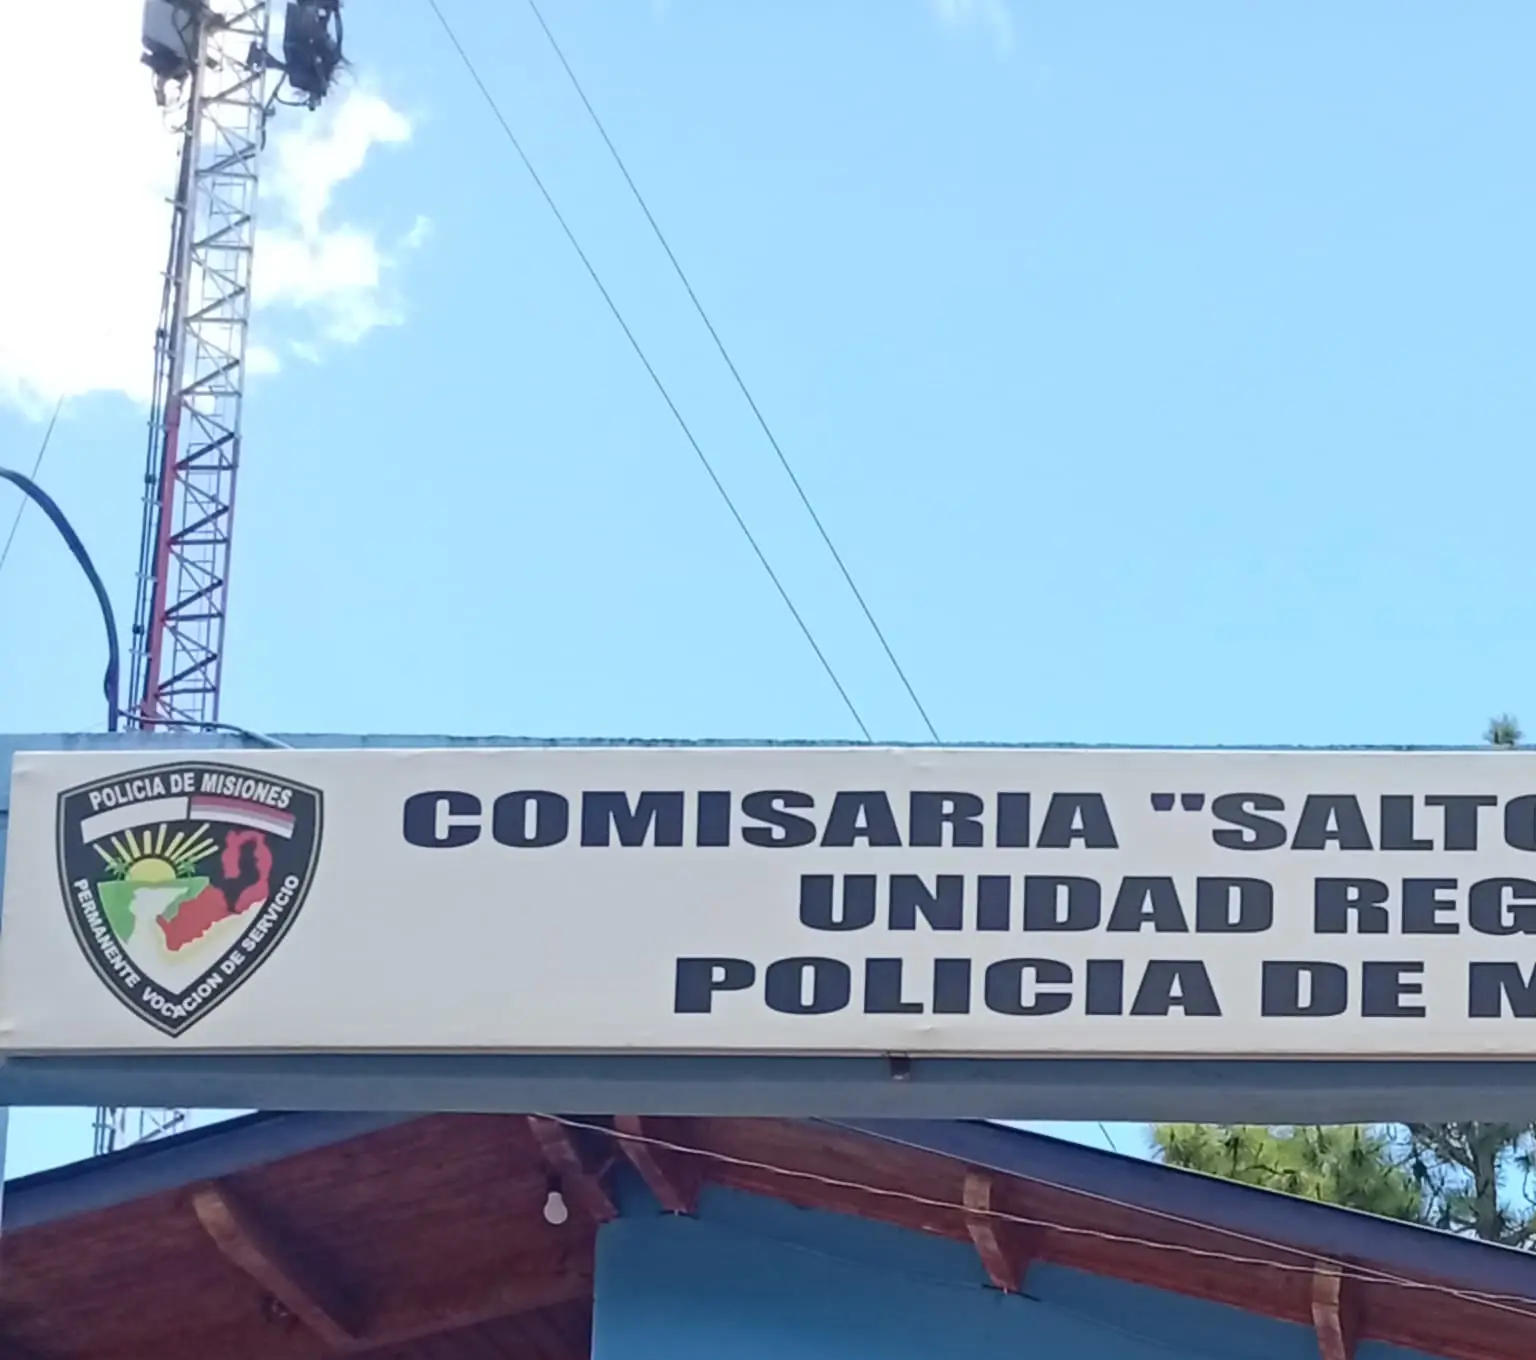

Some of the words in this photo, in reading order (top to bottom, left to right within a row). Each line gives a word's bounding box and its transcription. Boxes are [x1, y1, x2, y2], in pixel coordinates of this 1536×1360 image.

[88, 776, 164, 810] POLICIA
[169, 772, 195, 793] DE
[200, 772, 293, 809] MISIONES
[403, 790, 1118, 849] COMISARIA
[800, 874, 1273, 933] UNIDAD
[73, 878, 141, 988] PERMANENTE
[142, 973, 224, 1018] VOCACION
[220, 953, 245, 976] DE
[241, 875, 300, 953] SERVICIO
[674, 957, 1222, 1016] POLICIA
[1261, 961, 1425, 1017] DE
